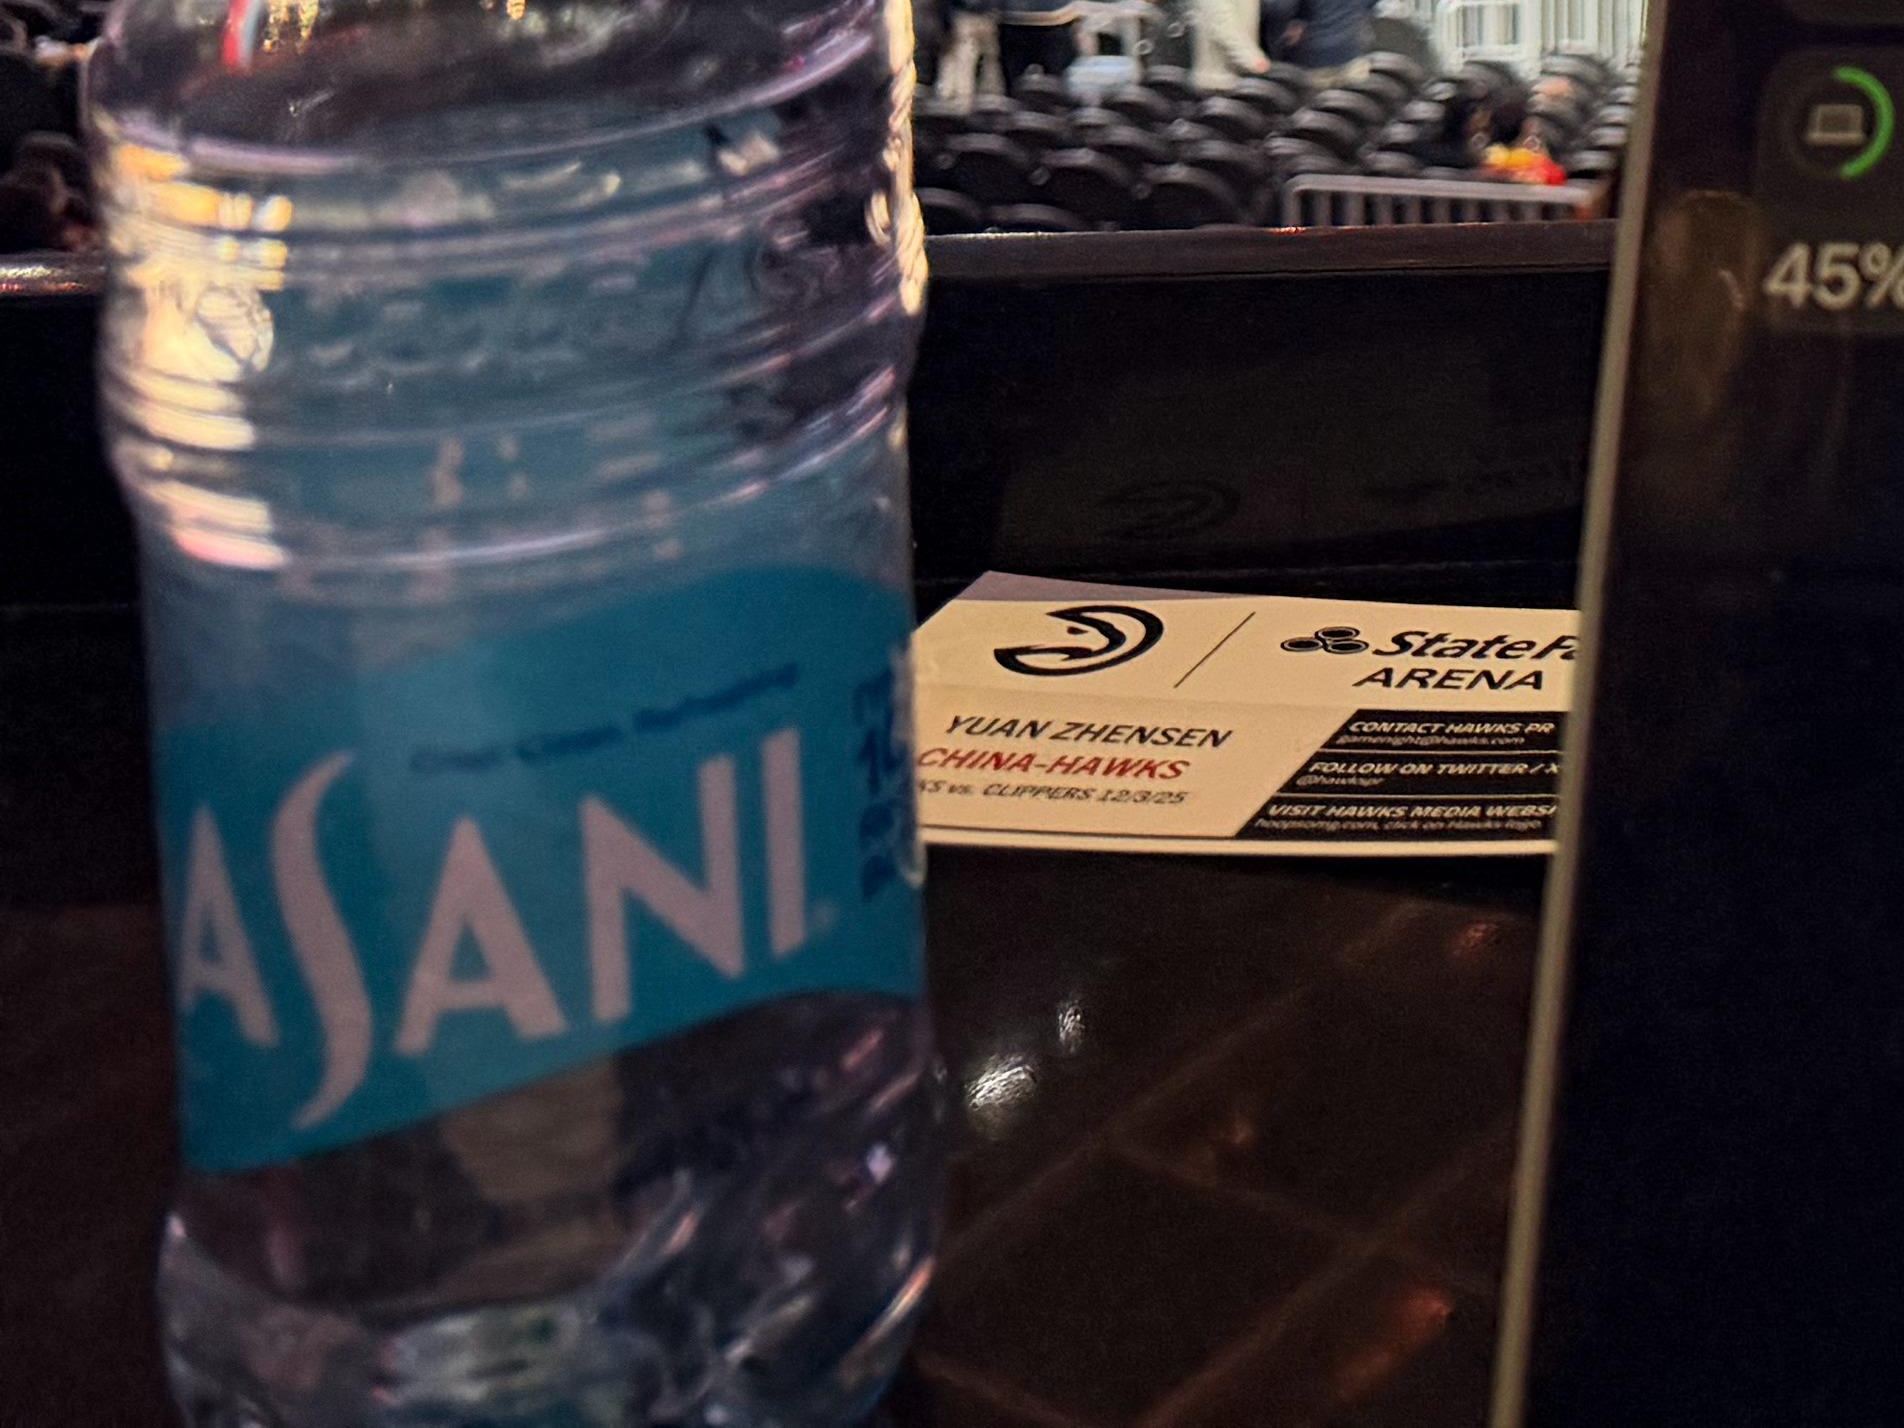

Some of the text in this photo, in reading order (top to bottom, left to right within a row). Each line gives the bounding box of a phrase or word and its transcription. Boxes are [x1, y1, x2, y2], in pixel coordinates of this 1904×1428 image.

[1352, 666, 1544, 691] ARENA
[946, 714, 1234, 749] YUAN ZHENSEN
[1349, 720, 1556, 735] CONTACT HAWKS PR
[917, 746, 1191, 781] CHINA-HAWKS
[1308, 761, 1400, 775] FOLLOW
[1399, 762, 1435, 776] ON
[1438, 762, 1530, 776] TWITTER
[983, 782, 1095, 801] CLIPPERS
[1096, 787, 1189, 805] 12/3/25
[1268, 804, 1559, 818] VISIT HAWKS MEDIA WEBSI
[177, 726, 807, 1132] ASANI
